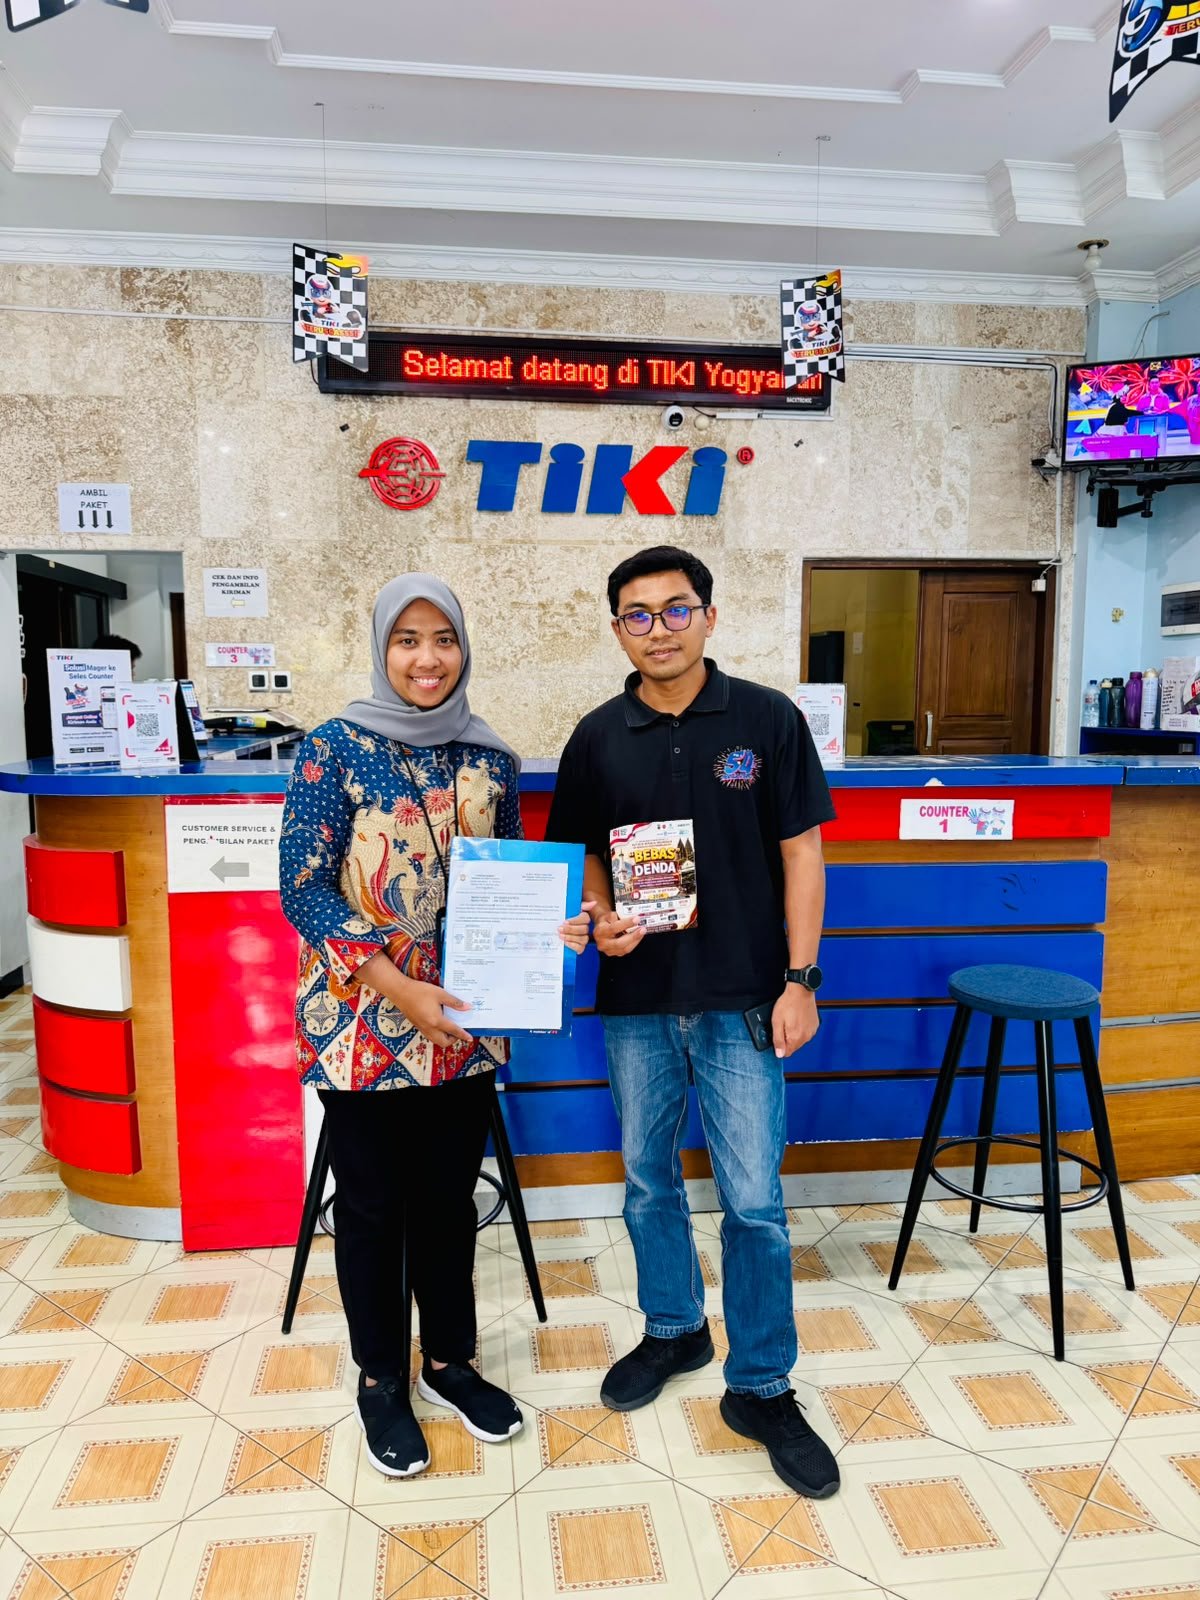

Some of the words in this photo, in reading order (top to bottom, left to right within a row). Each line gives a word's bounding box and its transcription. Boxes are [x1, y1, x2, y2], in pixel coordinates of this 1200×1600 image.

[404, 350, 513, 379] Selamat
[522, 355, 608, 390] datang
[618, 358, 639, 384] di
[646, 359, 696, 385] TIKI
[217, 646, 248, 654] COUNTER
[230, 654, 238, 663] 3
[920, 806, 969, 817] COUNTER
[940, 819, 948, 833] 1
[634, 861, 676, 876] DENDA
